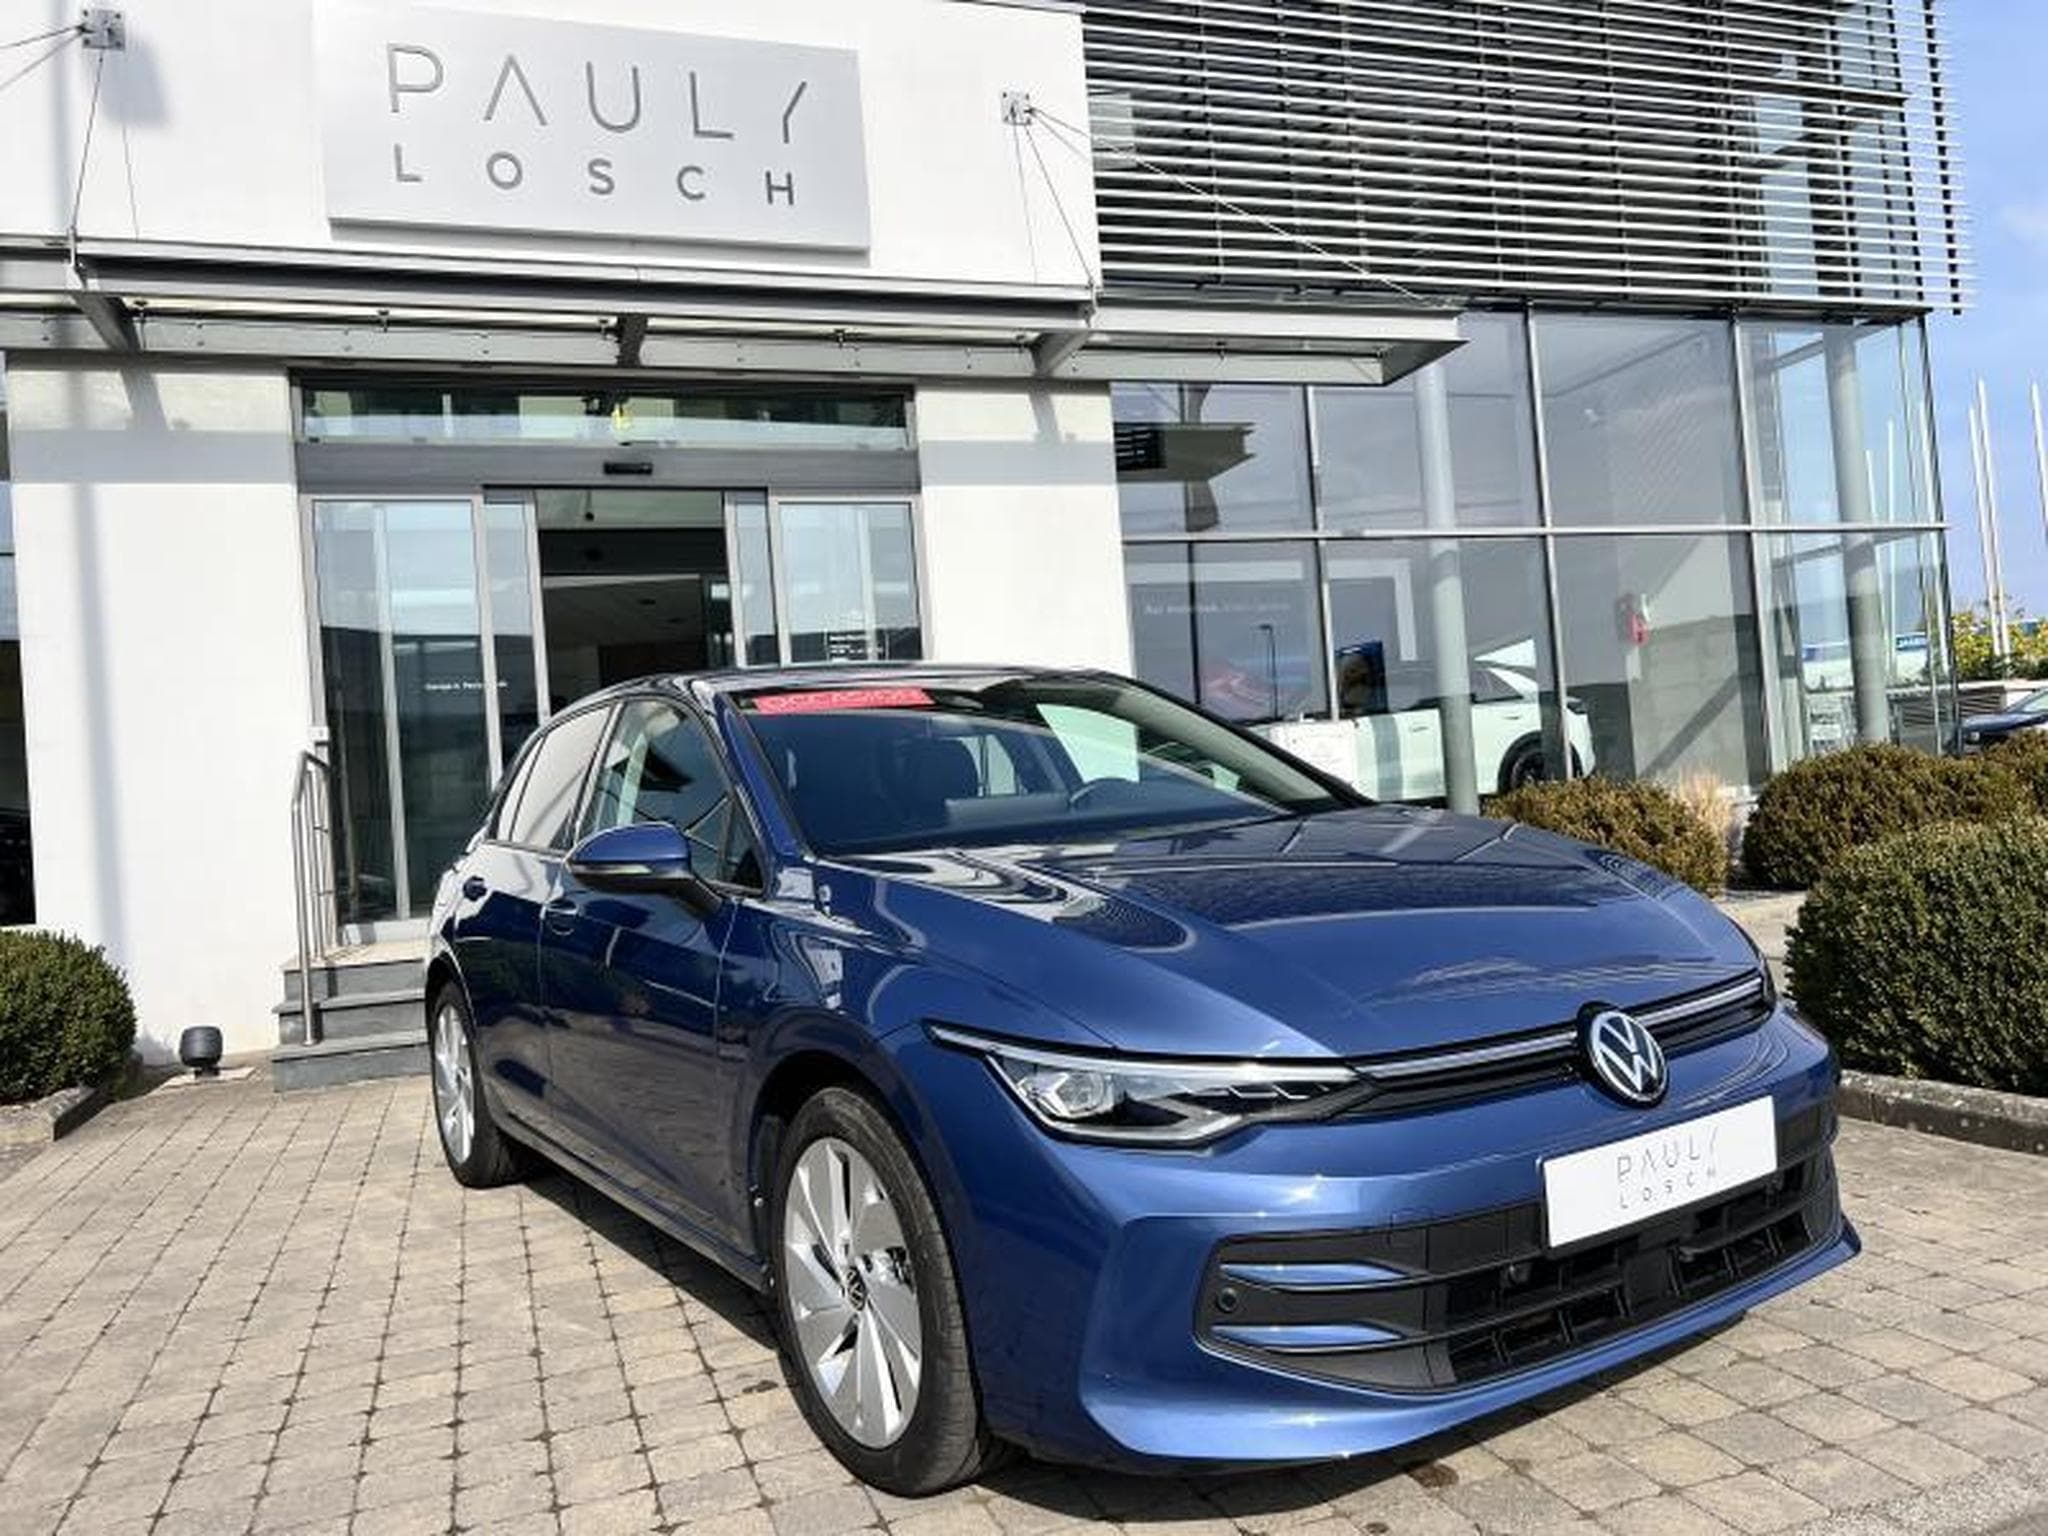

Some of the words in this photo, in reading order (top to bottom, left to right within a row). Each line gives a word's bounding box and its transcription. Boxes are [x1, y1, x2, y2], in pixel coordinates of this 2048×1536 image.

[387, 42, 807, 144] PAULY
[394, 143, 795, 206] LOSCH
[1594, 1012, 1663, 1099] VW
[1617, 1126, 1719, 1183] PAULY
[1620, 1166, 1717, 1209] LOSCH
